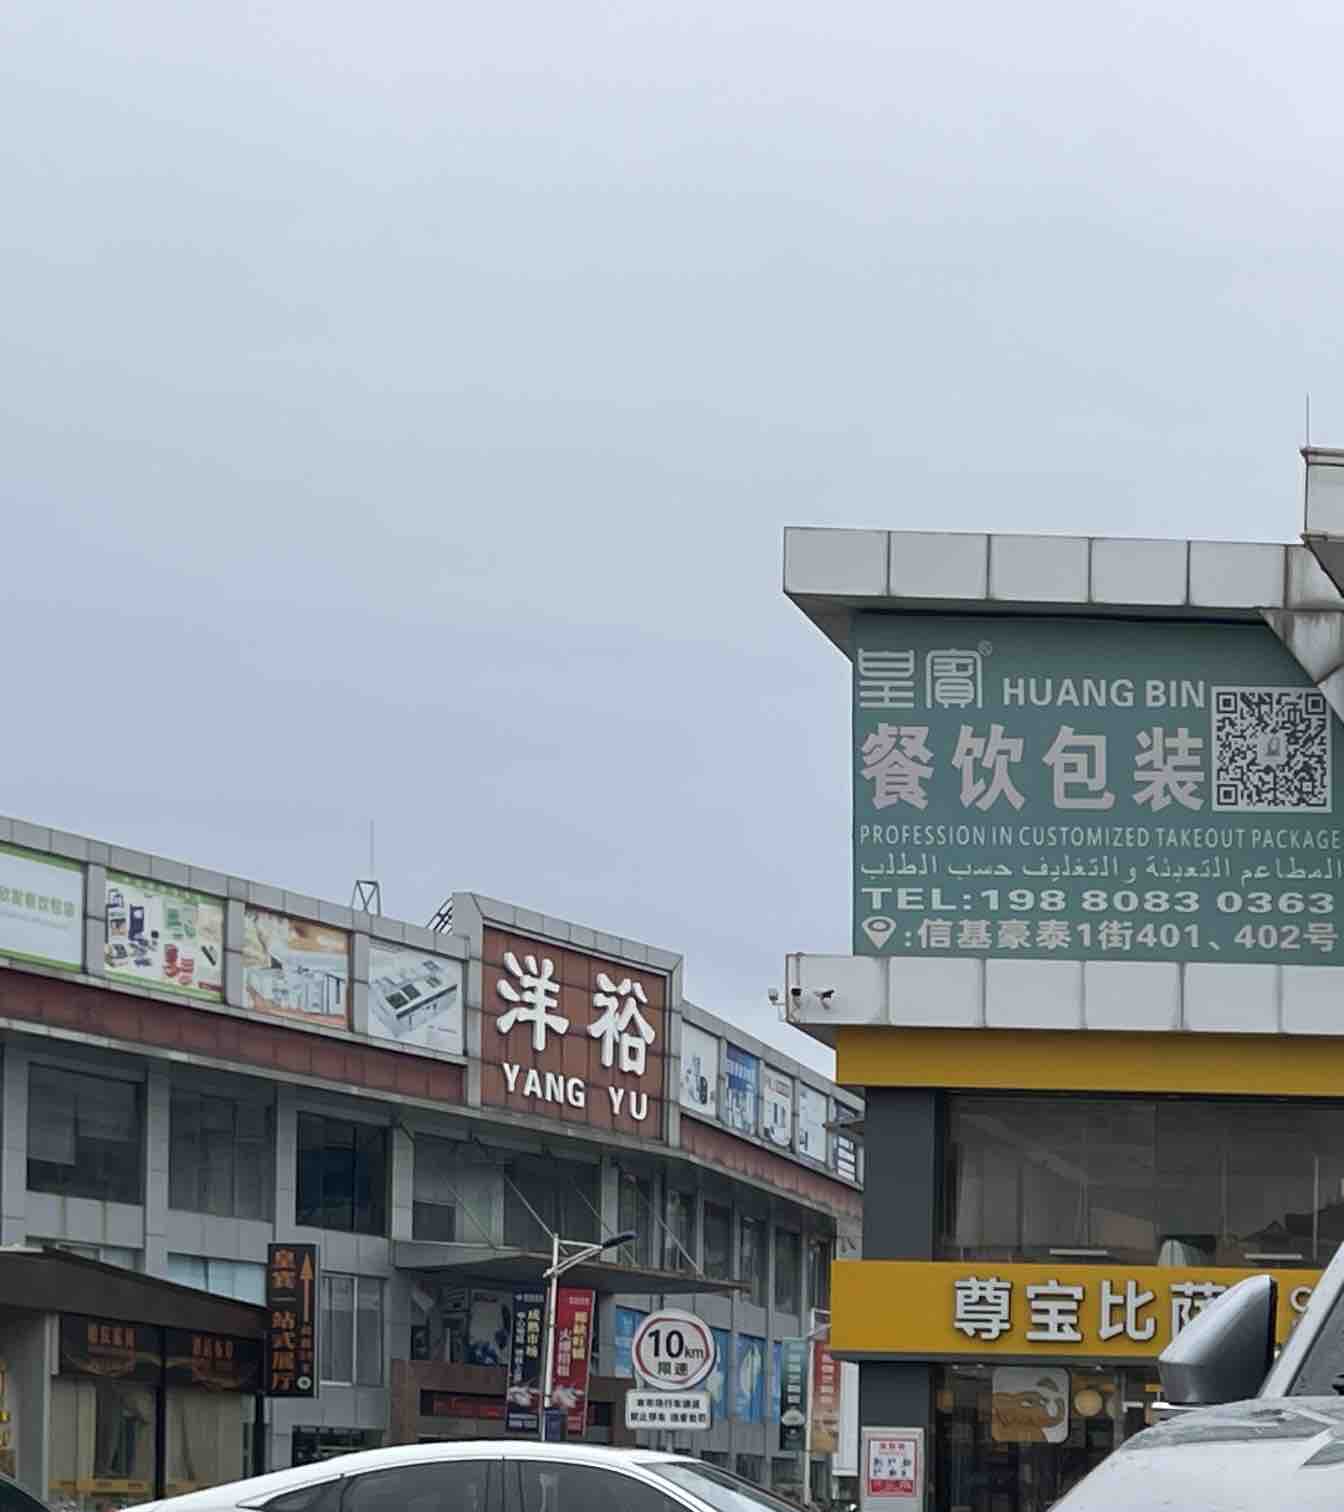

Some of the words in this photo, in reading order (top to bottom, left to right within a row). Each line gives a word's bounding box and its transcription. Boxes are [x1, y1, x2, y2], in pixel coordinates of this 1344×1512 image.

[1002, 676, 1135, 708] HUANG
[1145, 679, 1206, 708] BIN
[861, 722, 1205, 812] 餐饮包装
[859, 824, 986, 846] PROFESSION
[991, 826, 1013, 846] IN
[1018, 825, 1149, 848] CUSTOMIZED
[1156, 827, 1246, 849] TAKEOUT
[1251, 828, 1341, 850] PACKAGE
[1081, 889, 1201, 913] 8083
[1215, 891, 1335, 914] 0363
[496, 951, 656, 1077] 洋裕
[503, 1061, 587, 1109] YANG
[608, 1085, 649, 1122] YU
[657, 1361, 689, 1376] 限速
